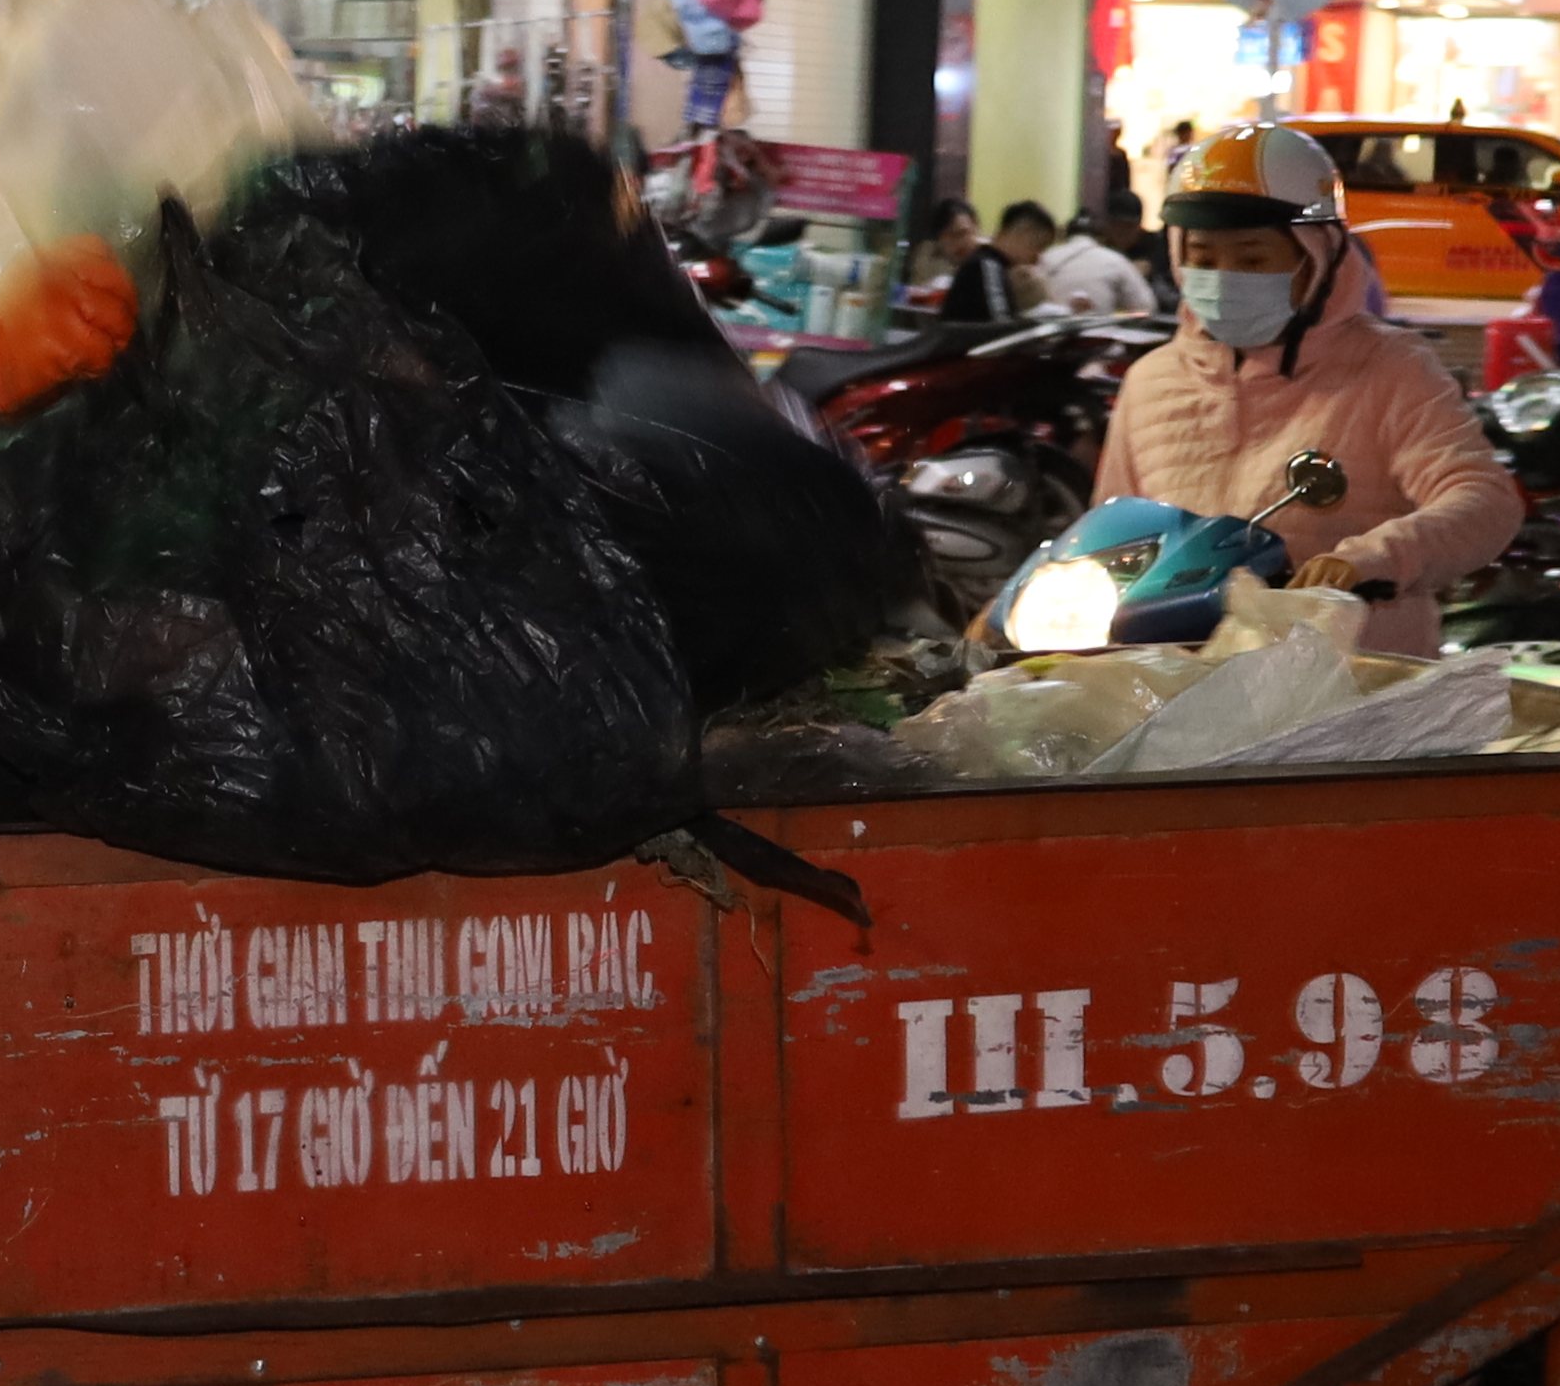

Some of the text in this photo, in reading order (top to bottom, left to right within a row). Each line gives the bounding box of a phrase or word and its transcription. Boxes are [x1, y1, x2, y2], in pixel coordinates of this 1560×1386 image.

[130, 880, 654, 1035] THỜI GIAN THU GOM RÁC
[159, 1040, 630, 1196] TỪ 17 GIỜ ĐẾN 21 GIỜ
